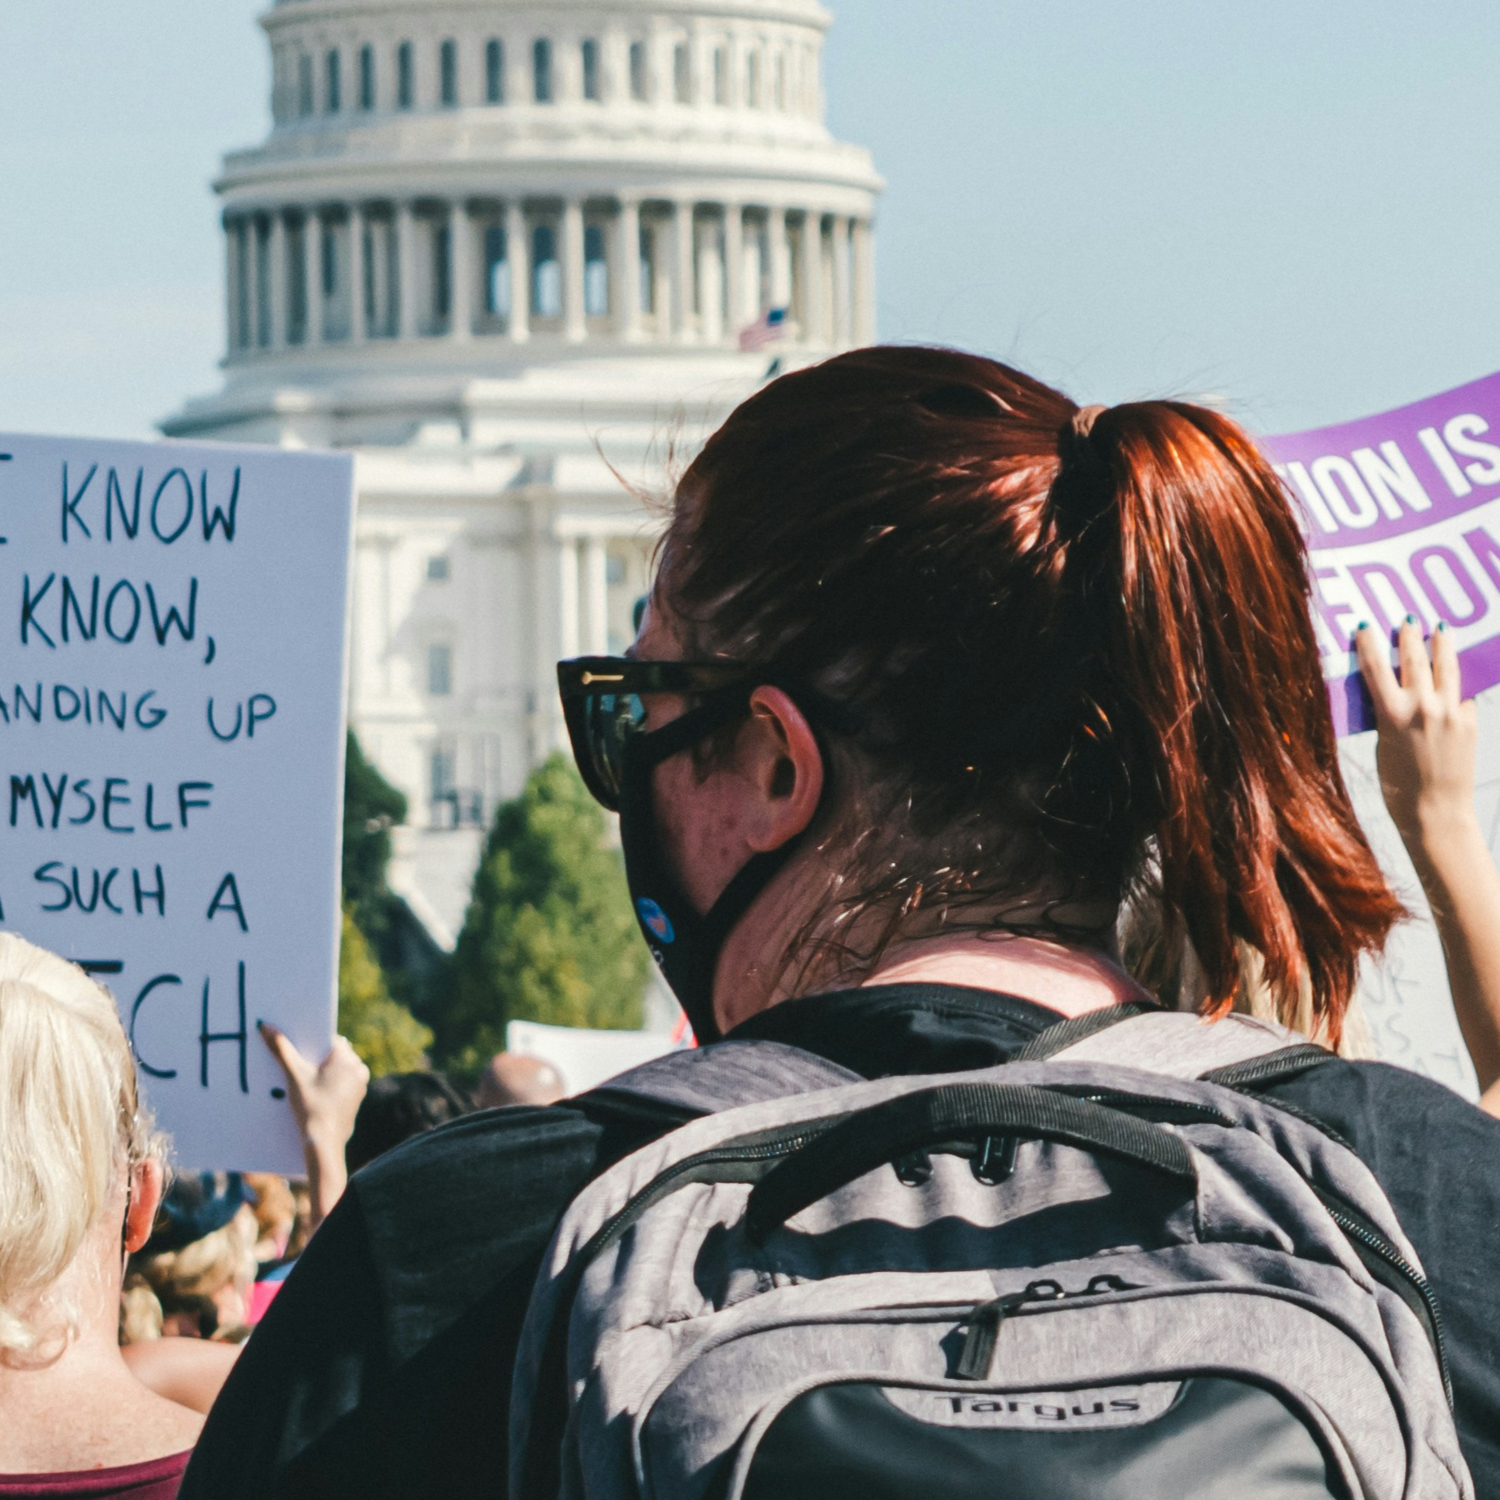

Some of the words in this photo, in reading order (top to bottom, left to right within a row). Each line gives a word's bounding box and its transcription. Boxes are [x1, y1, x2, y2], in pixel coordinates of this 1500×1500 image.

[61, 463, 241, 544] KNOW
[20, 572, 216, 664] KNOW,
[207, 694, 277, 741] UP
[10, 773, 214, 832] MYSELF
[33, 861, 166, 916] SUCH
[207, 872, 249, 932] A
[934, 1396, 1140, 1420] Targus
